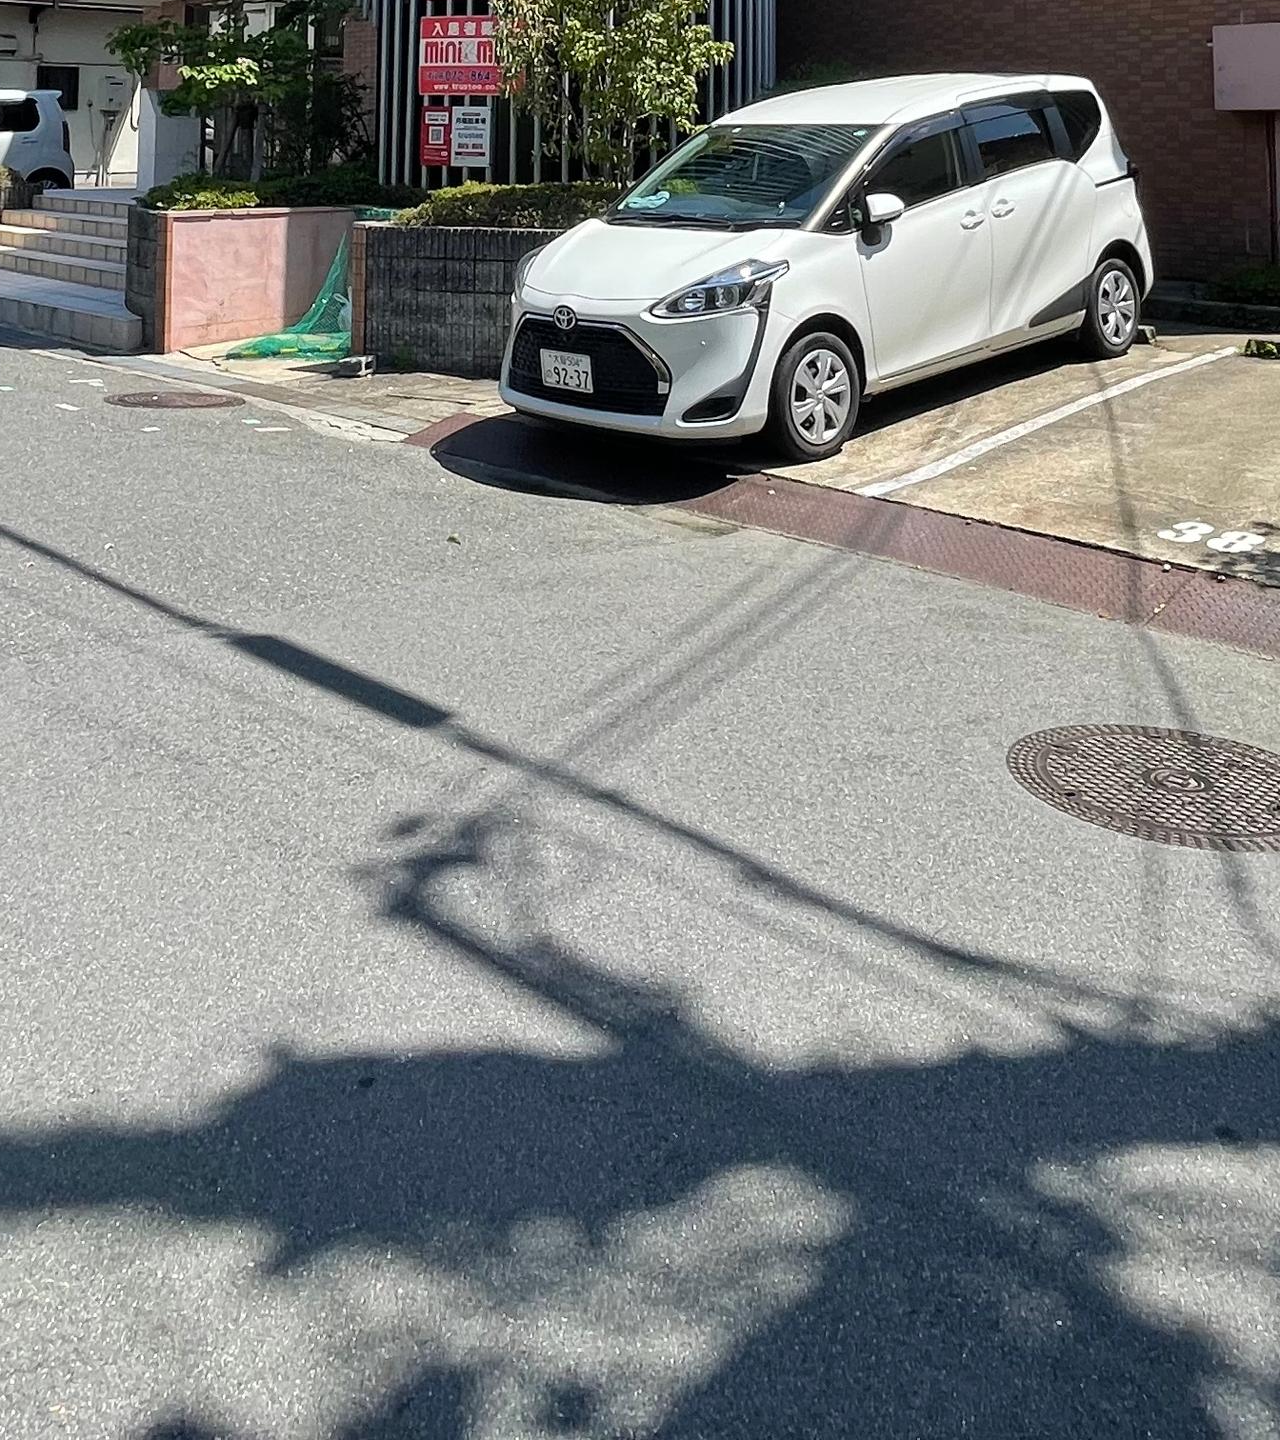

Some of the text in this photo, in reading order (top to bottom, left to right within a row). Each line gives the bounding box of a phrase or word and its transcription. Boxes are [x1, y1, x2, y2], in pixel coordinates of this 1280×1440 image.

[424, 41, 462, 63] mini
[553, 366, 589, 389] 92-37
[1157, 520, 1266, 553] 38
